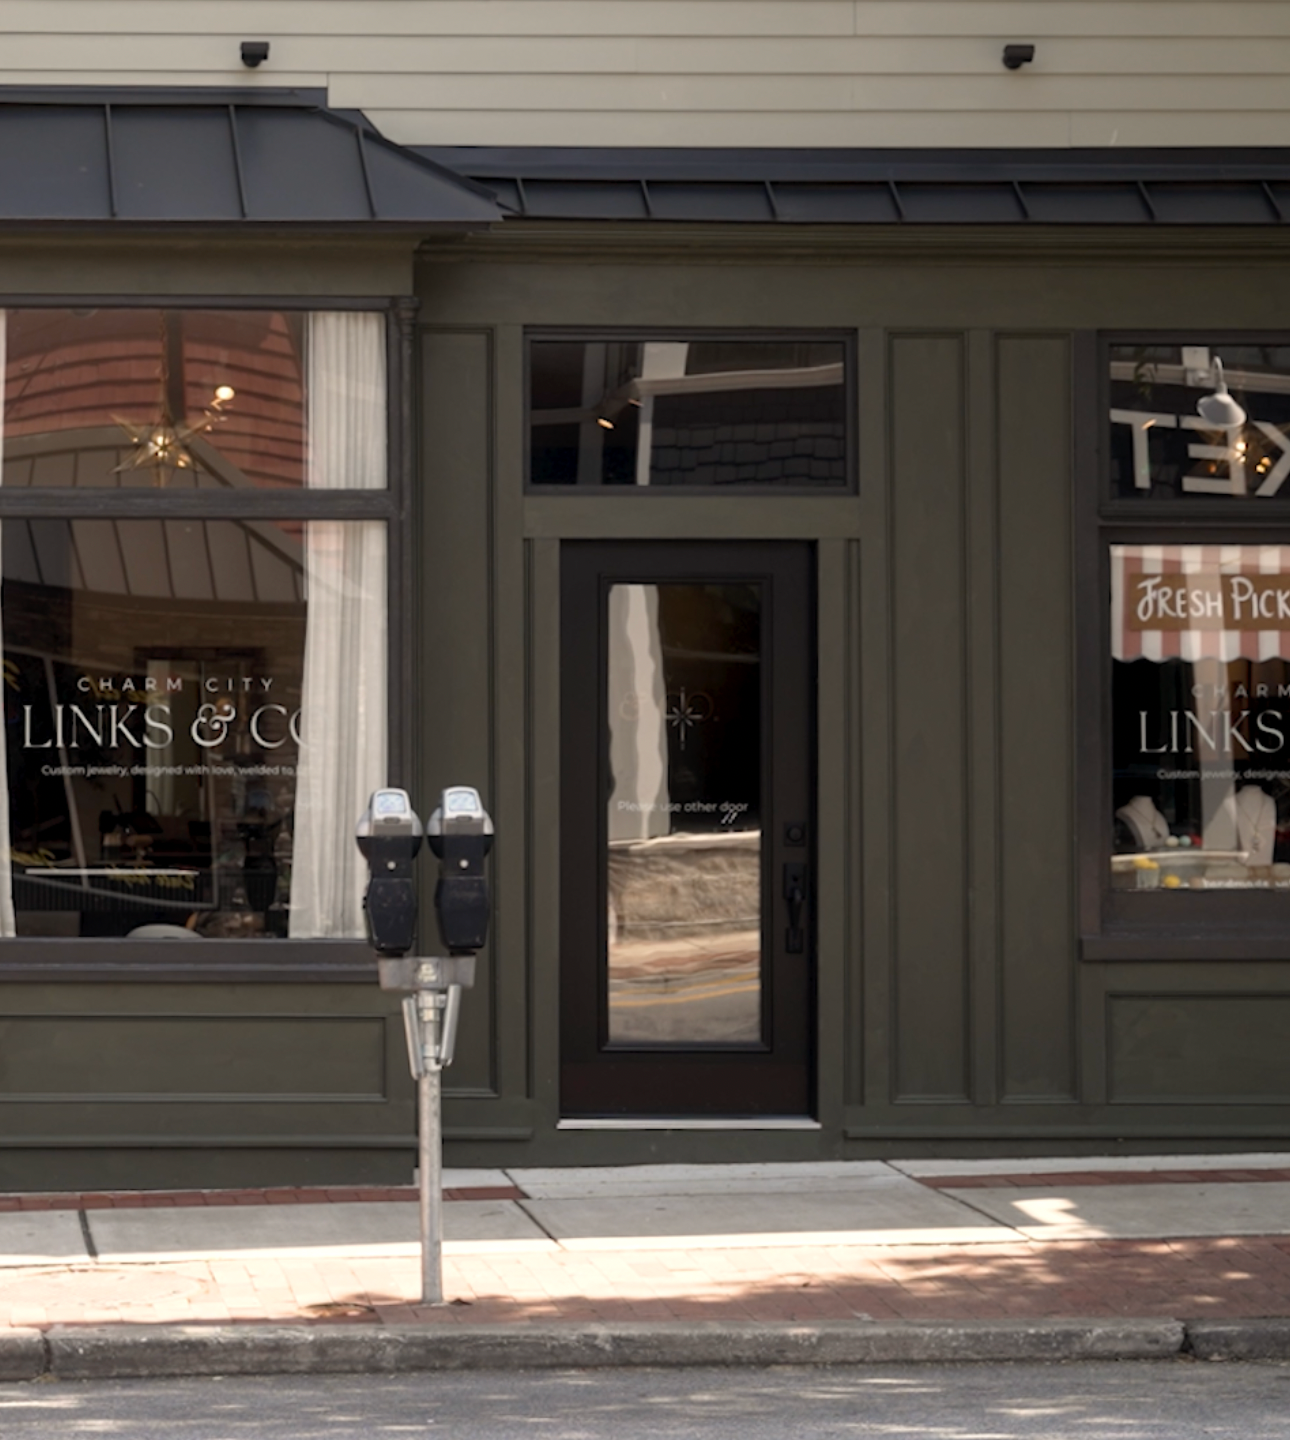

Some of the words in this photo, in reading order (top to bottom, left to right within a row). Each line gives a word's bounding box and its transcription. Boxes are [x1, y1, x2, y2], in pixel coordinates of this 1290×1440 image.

[1137, 575, 1223, 622] FRESH
[1230, 576, 1290, 620] PICK
[77, 677, 184, 692] CHARM
[205, 677, 274, 692] CITY
[1191, 684, 1290, 698] CHARM
[22, 703, 173, 749] LINKS
[190, 702, 236, 748] &
[1139, 709, 1285, 753] LINKS
[41, 765, 85, 776] Custom
[86, 765, 129, 777] jewelry,
[130, 765, 183, 777] designed
[185, 765, 210, 775] with
[211, 765, 236, 777] love,
[238, 764, 280, 776] welded
[281, 765, 295, 776] to
[1156, 768, 1200, 780] Custom
[660, 802, 682, 812] use
[683, 801, 717, 812] other
[719, 800, 749, 812] door
